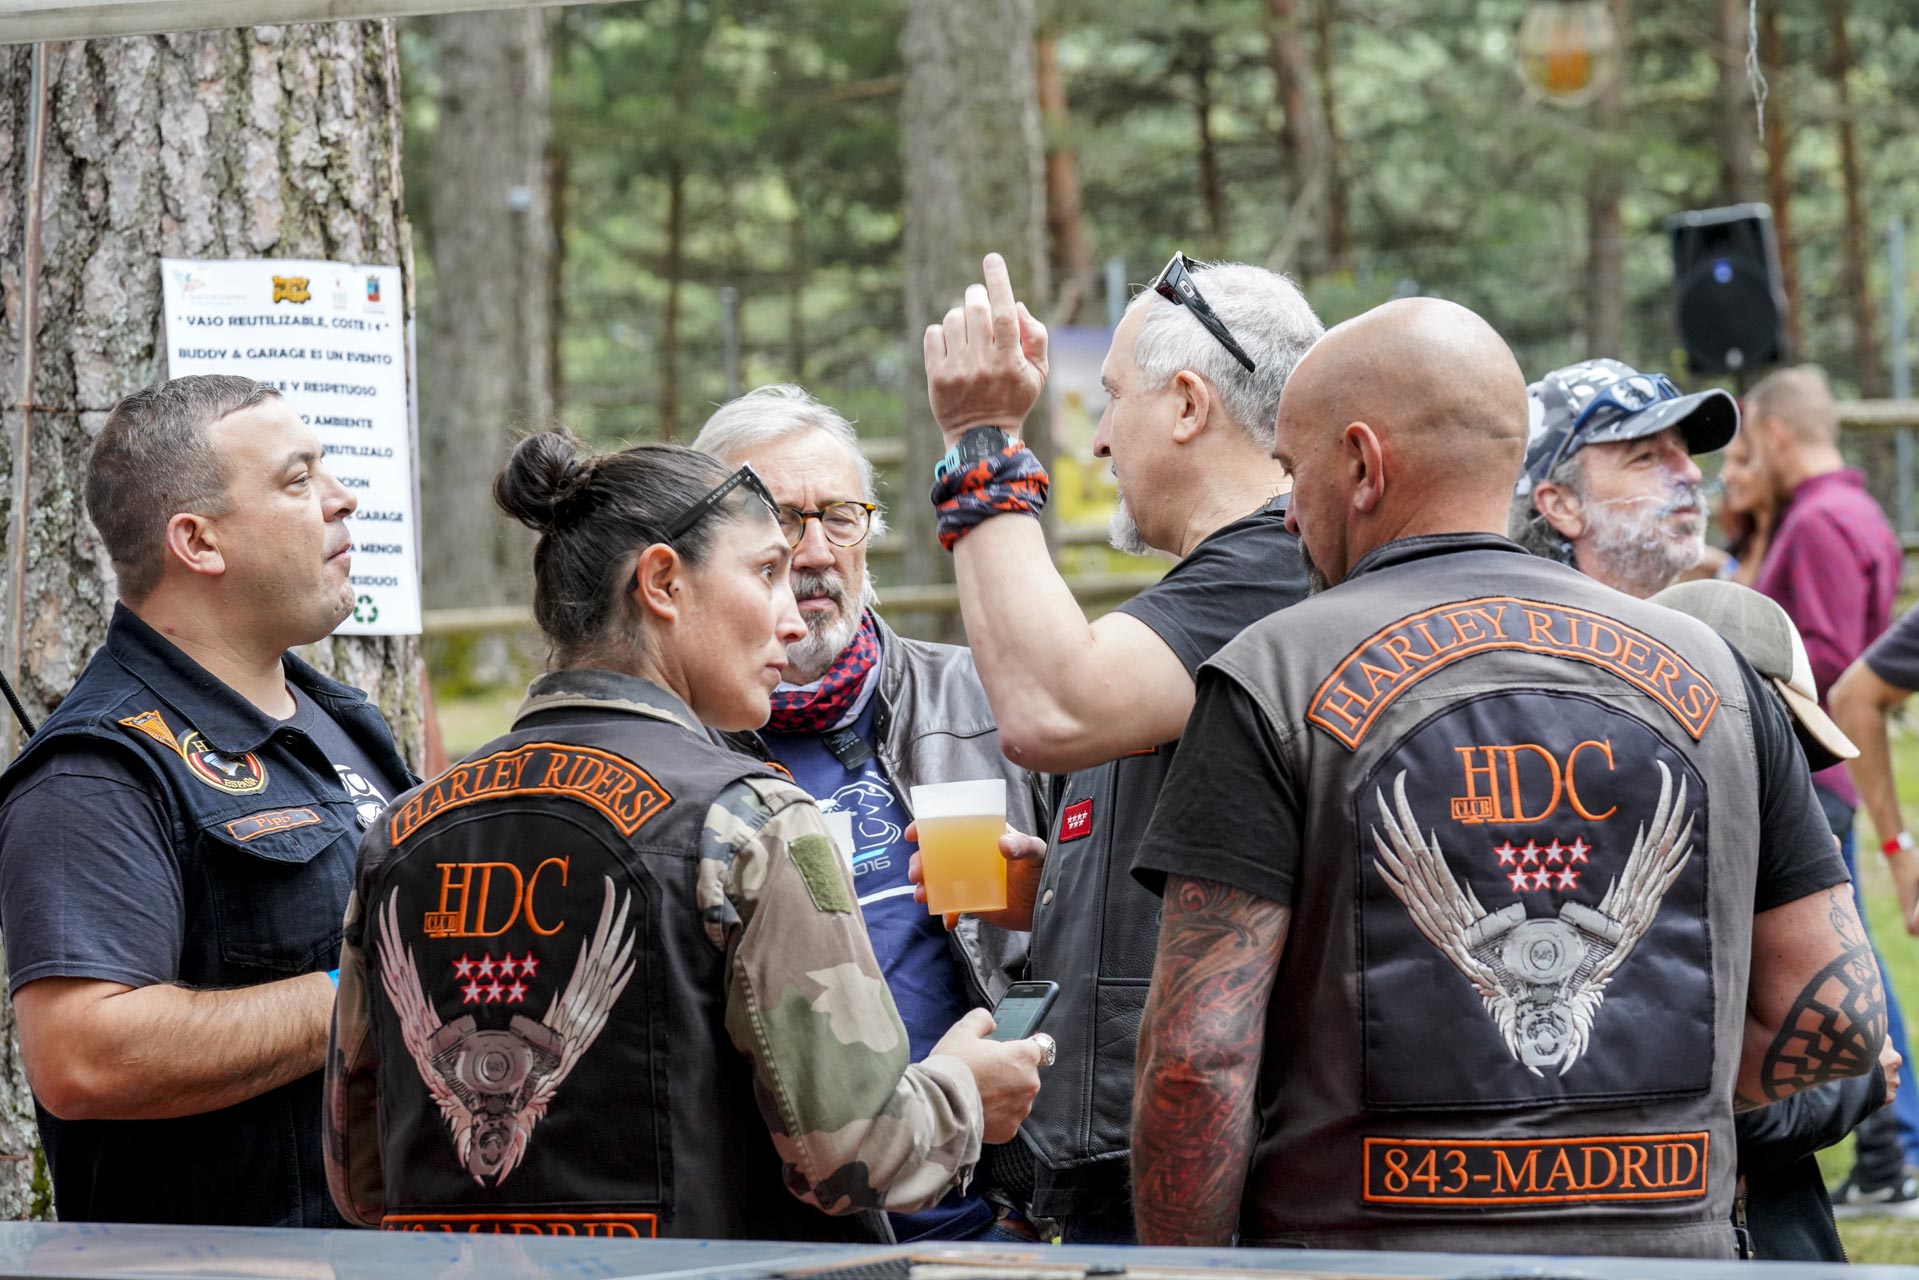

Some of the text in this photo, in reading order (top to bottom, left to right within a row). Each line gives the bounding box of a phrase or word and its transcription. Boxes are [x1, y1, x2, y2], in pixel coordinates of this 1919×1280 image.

[187, 315, 223, 326] VASO
[228, 315, 328, 328] REUTILIZABLE,
[332, 317, 364, 330] COSTE
[178, 348, 392, 365] BUDDY & GARAGE ES UN EVENTO
[291, 381, 300, 391] Y
[304, 382, 377, 397] RESPETUOSO
[314, 415, 373, 429] AMBIENTE
[337, 477, 369, 488] CION
[356, 510, 403, 522] GARAGE
[361, 543, 402, 554] MENOR
[1322, 606, 1711, 730] HARLEY RIDERS
[223, 776, 259, 788] ESPAÑA
[1455, 739, 1617, 824] HDC
[402, 751, 656, 835] HARLEY RIDERS
[1454, 799, 1490, 816] CLUB
[853, 855, 891, 876] 016
[429, 855, 570, 938] HDC
[426, 914, 457, 930] CLUB
[1383, 1142, 1698, 1194] 843-MADRID
